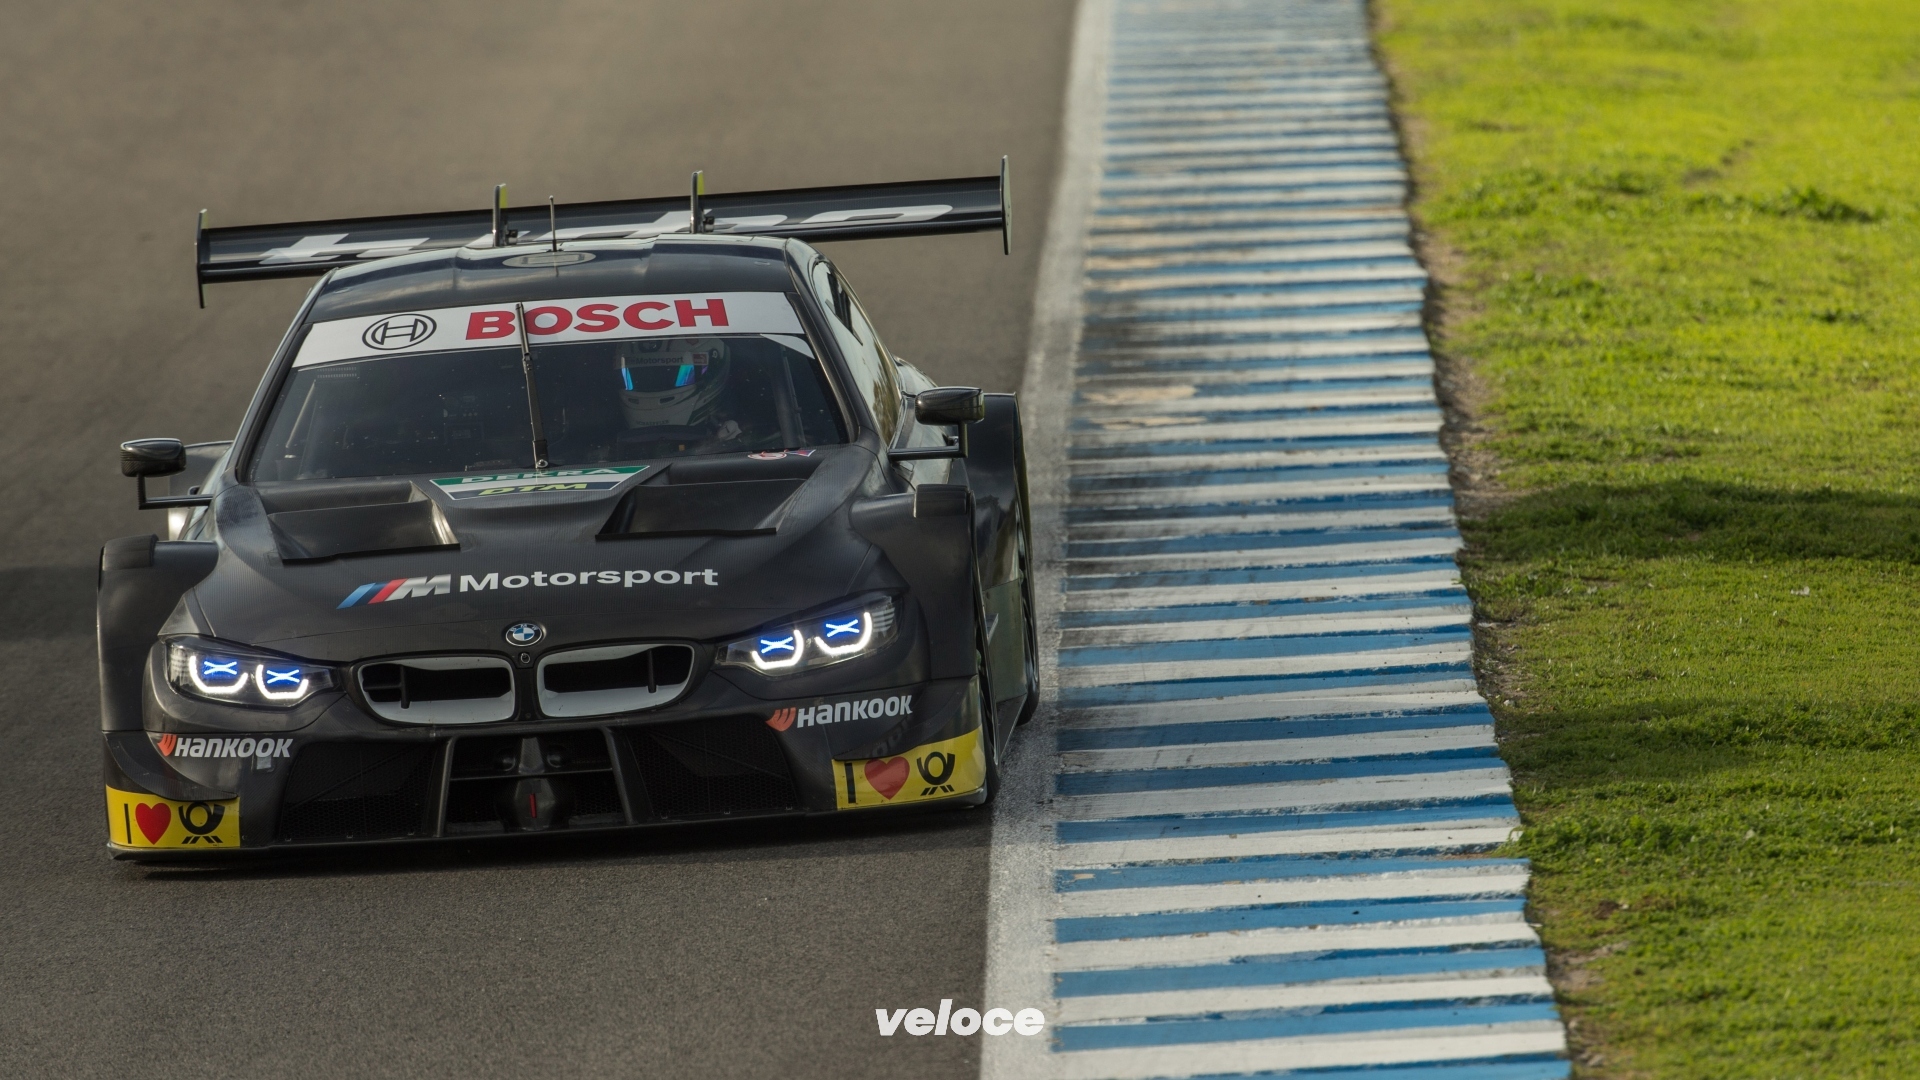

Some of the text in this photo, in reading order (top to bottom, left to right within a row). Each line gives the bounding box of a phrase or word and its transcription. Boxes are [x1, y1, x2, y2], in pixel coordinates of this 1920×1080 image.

[465, 298, 730, 341] BOSCH
[461, 468, 621, 484] DEKRA
[478, 483, 588, 496] DTM
[459, 568, 719, 593] Motorsport
